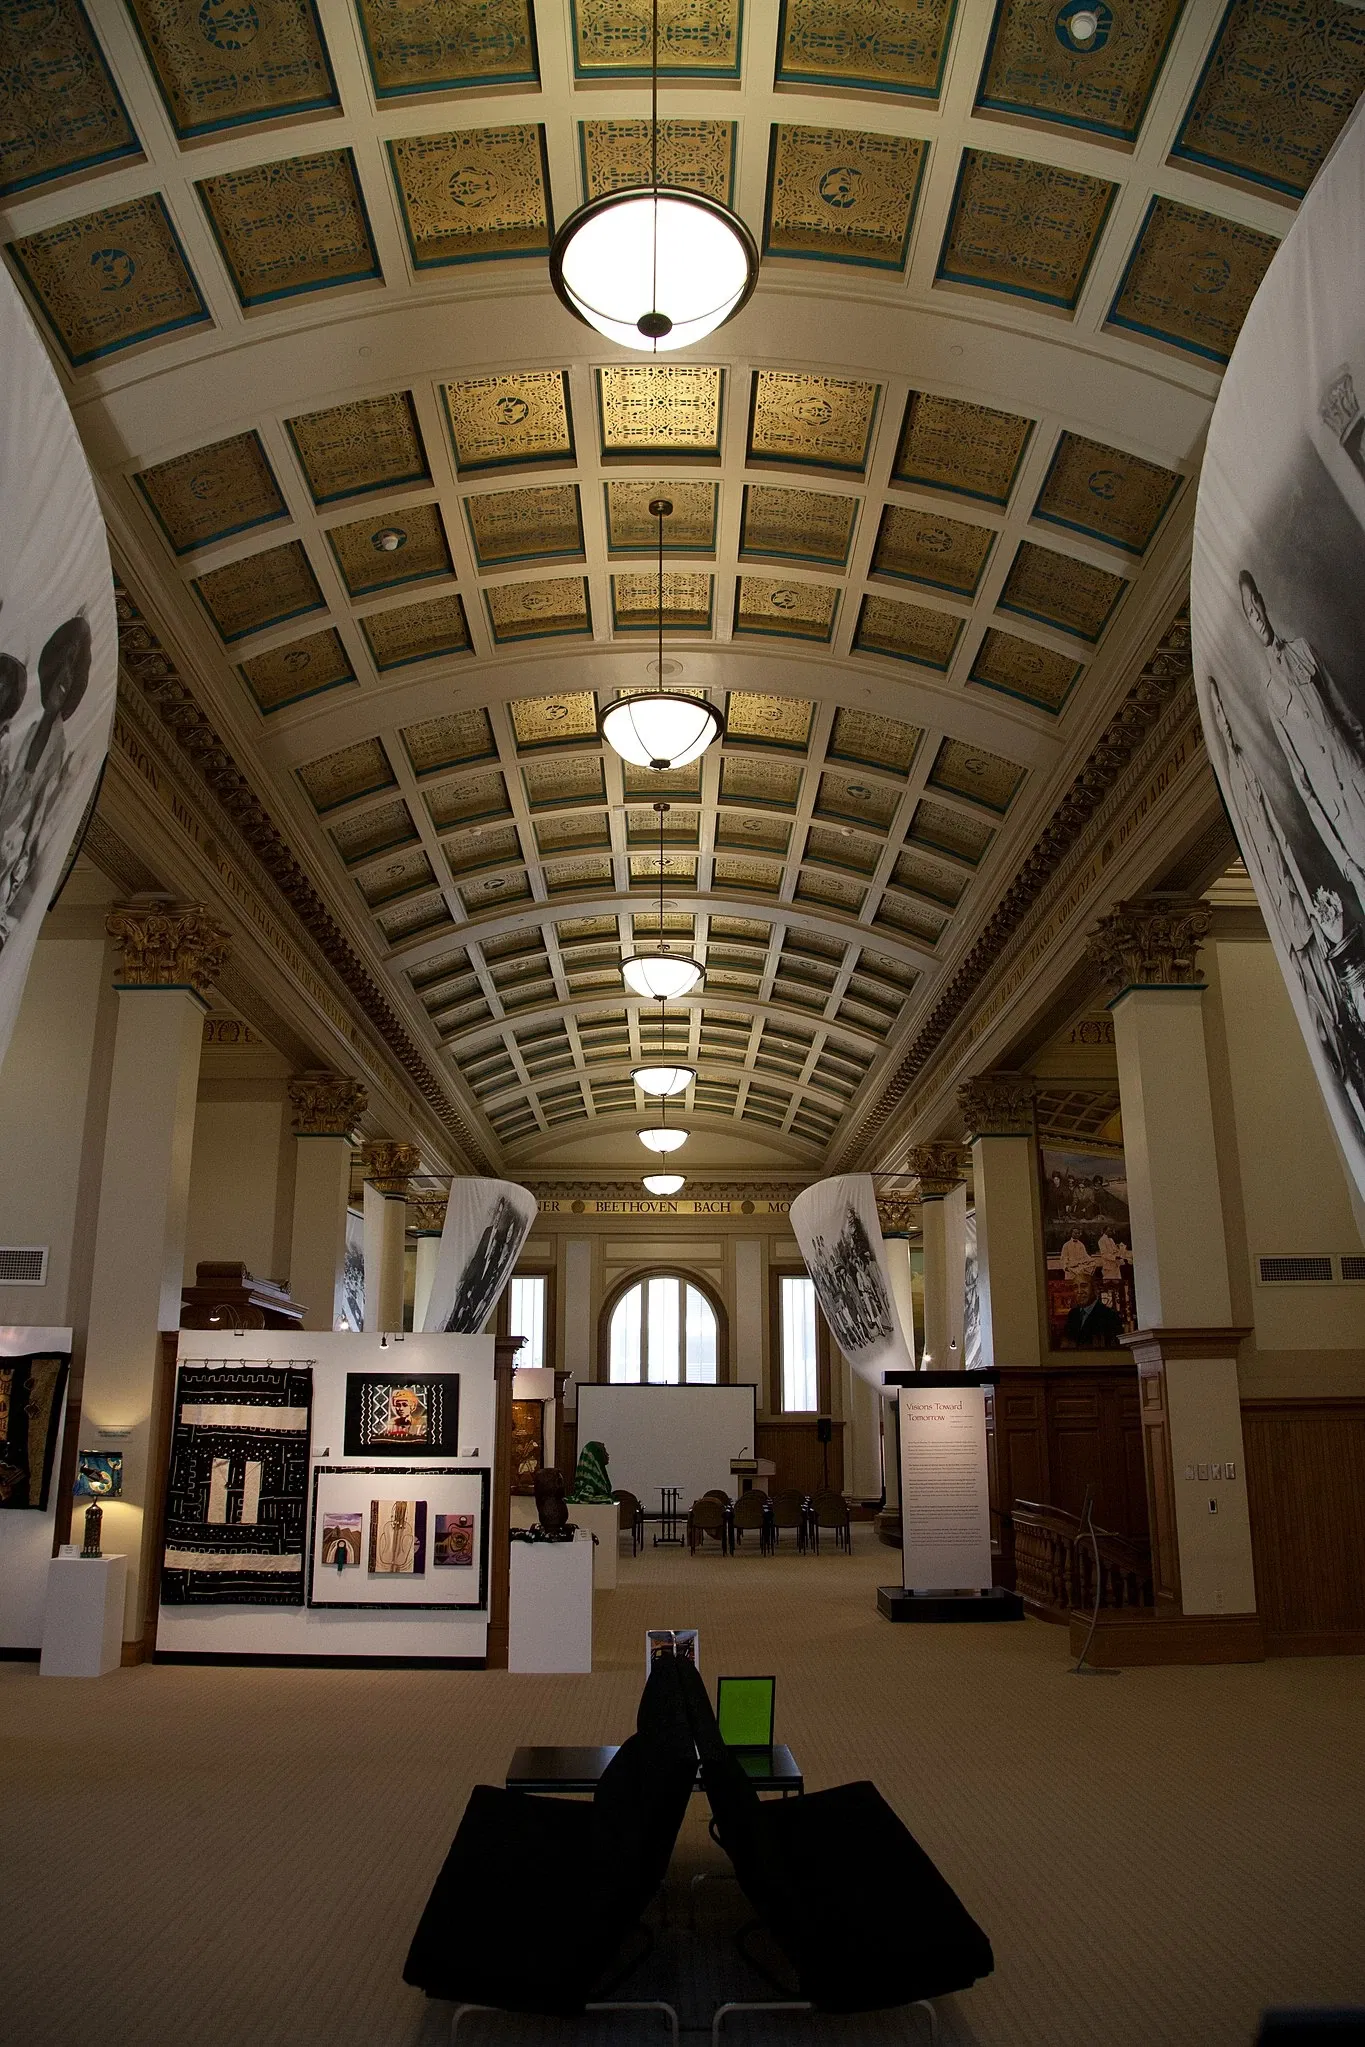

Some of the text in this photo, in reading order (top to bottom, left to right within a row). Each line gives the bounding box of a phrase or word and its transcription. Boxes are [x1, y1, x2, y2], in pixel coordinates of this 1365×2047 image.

[1119, 743, 1186, 844] PETRARCH
[596, 1201, 731, 1212] BEETHOVEN BACH
[768, 1201, 793, 1212] MO
[906, 1401, 963, 1411] Visions Toward
[907, 1413, 946, 1422] Tomorrow
